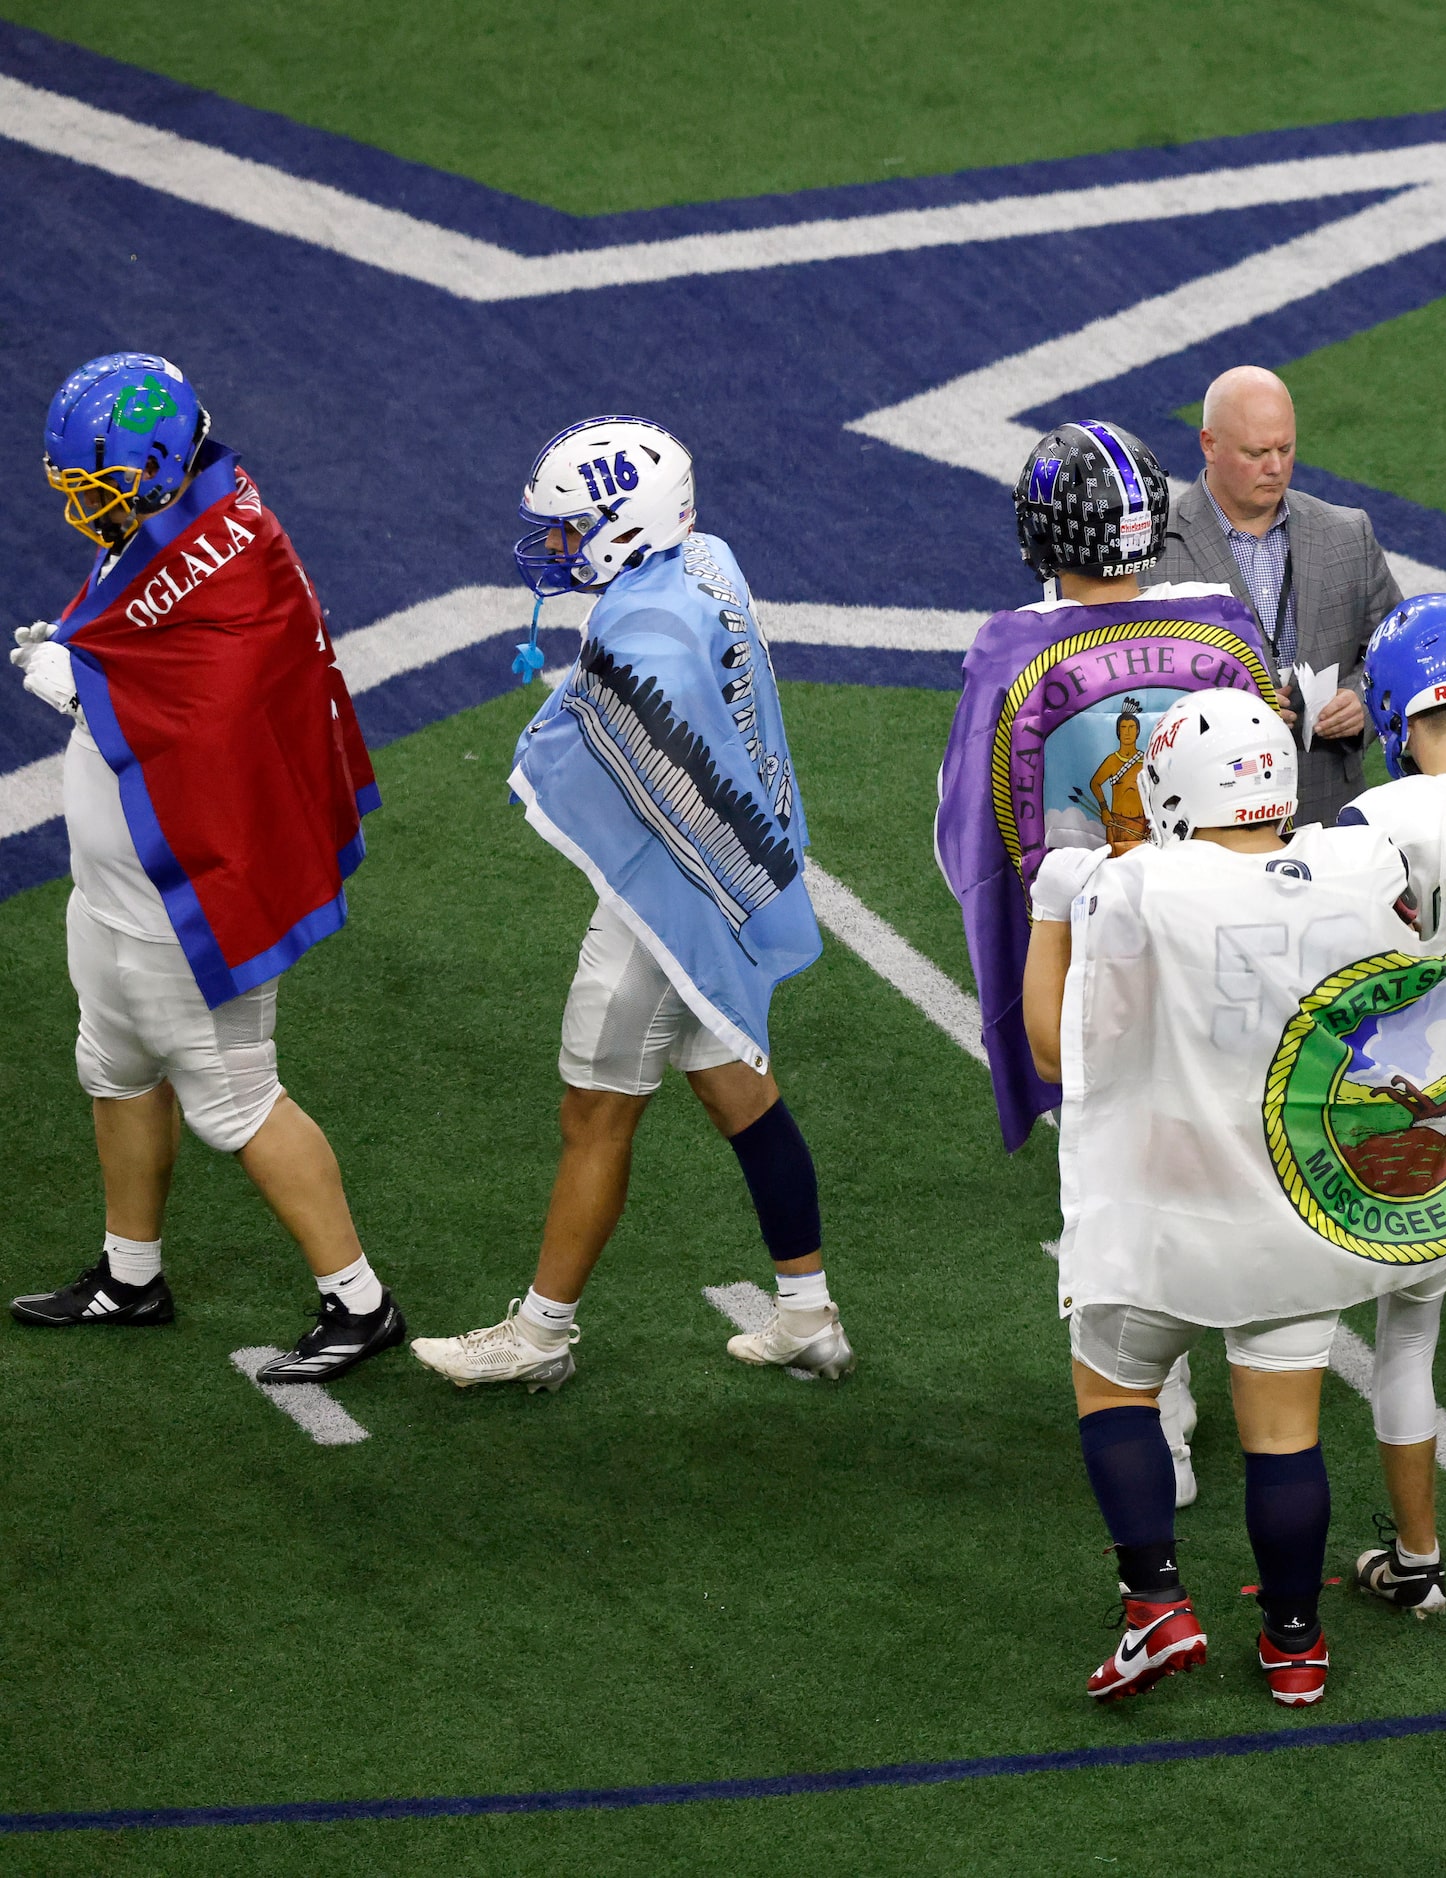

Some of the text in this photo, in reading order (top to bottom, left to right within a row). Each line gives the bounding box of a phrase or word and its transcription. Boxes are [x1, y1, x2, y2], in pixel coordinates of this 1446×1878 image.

[577, 450, 639, 502] 116
[1028, 457, 1063, 506] N
[125, 515, 257, 627] OGLALA
[1102, 556, 1157, 577] RACERS
[1043, 665, 1088, 711] OF
[1096, 646, 1176, 682] THE
[1259, 752, 1274, 769] 78
[1233, 801, 1293, 823] Riddell
[1326, 976, 1408, 1029] REAT
